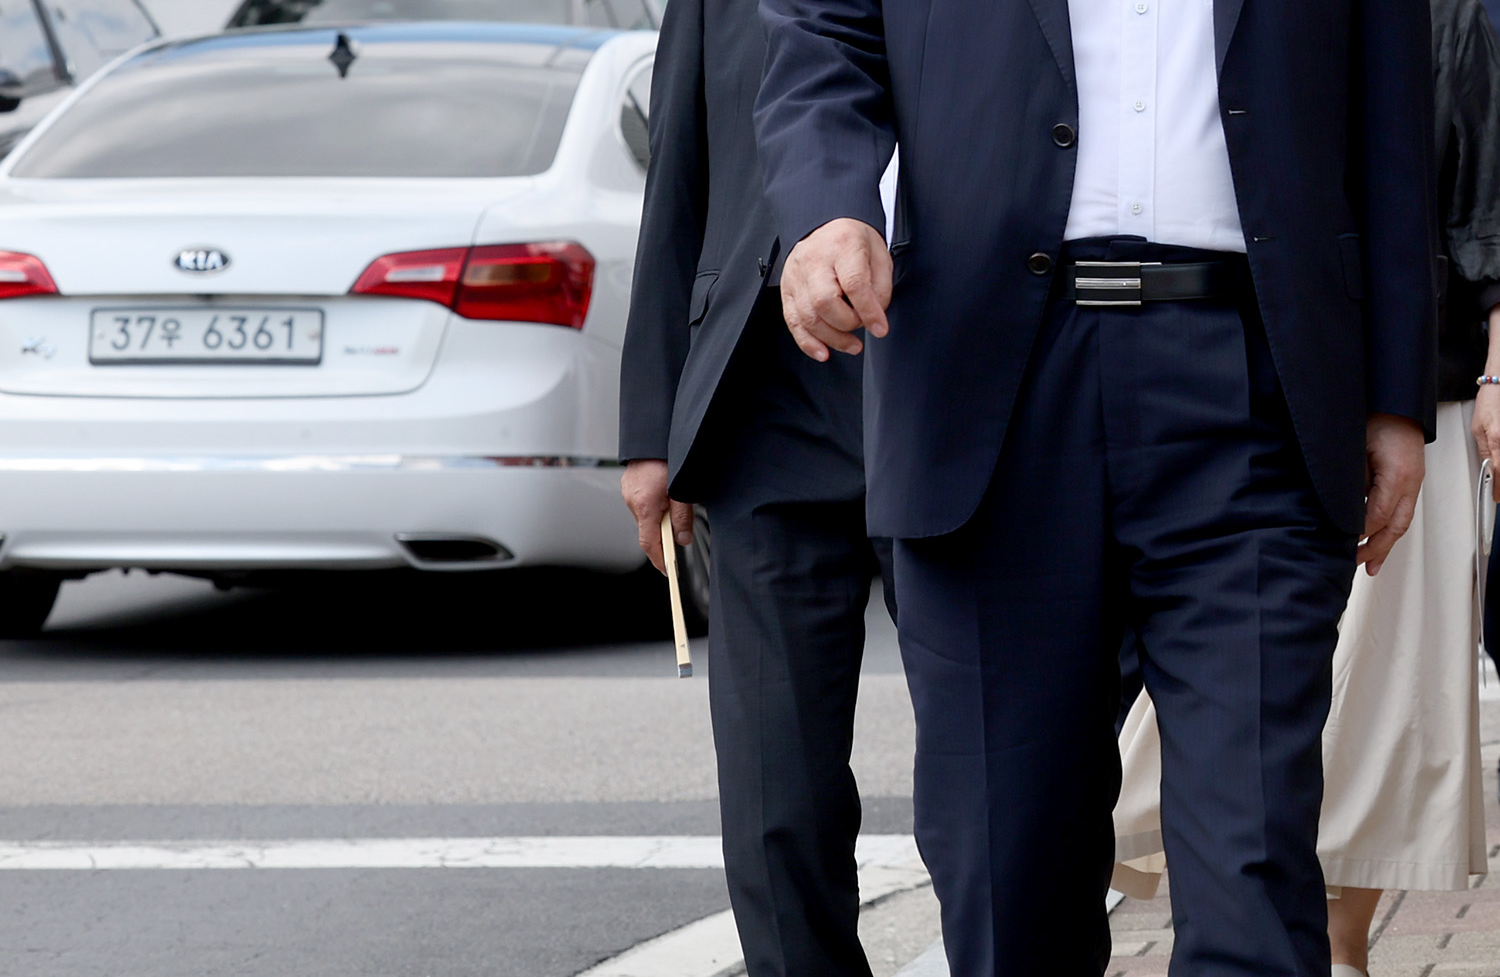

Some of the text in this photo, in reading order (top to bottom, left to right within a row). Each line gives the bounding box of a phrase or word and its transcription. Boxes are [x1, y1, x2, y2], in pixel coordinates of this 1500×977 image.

[179, 250, 224, 272] KIA
[109, 314, 298, 351] 37우 6361
